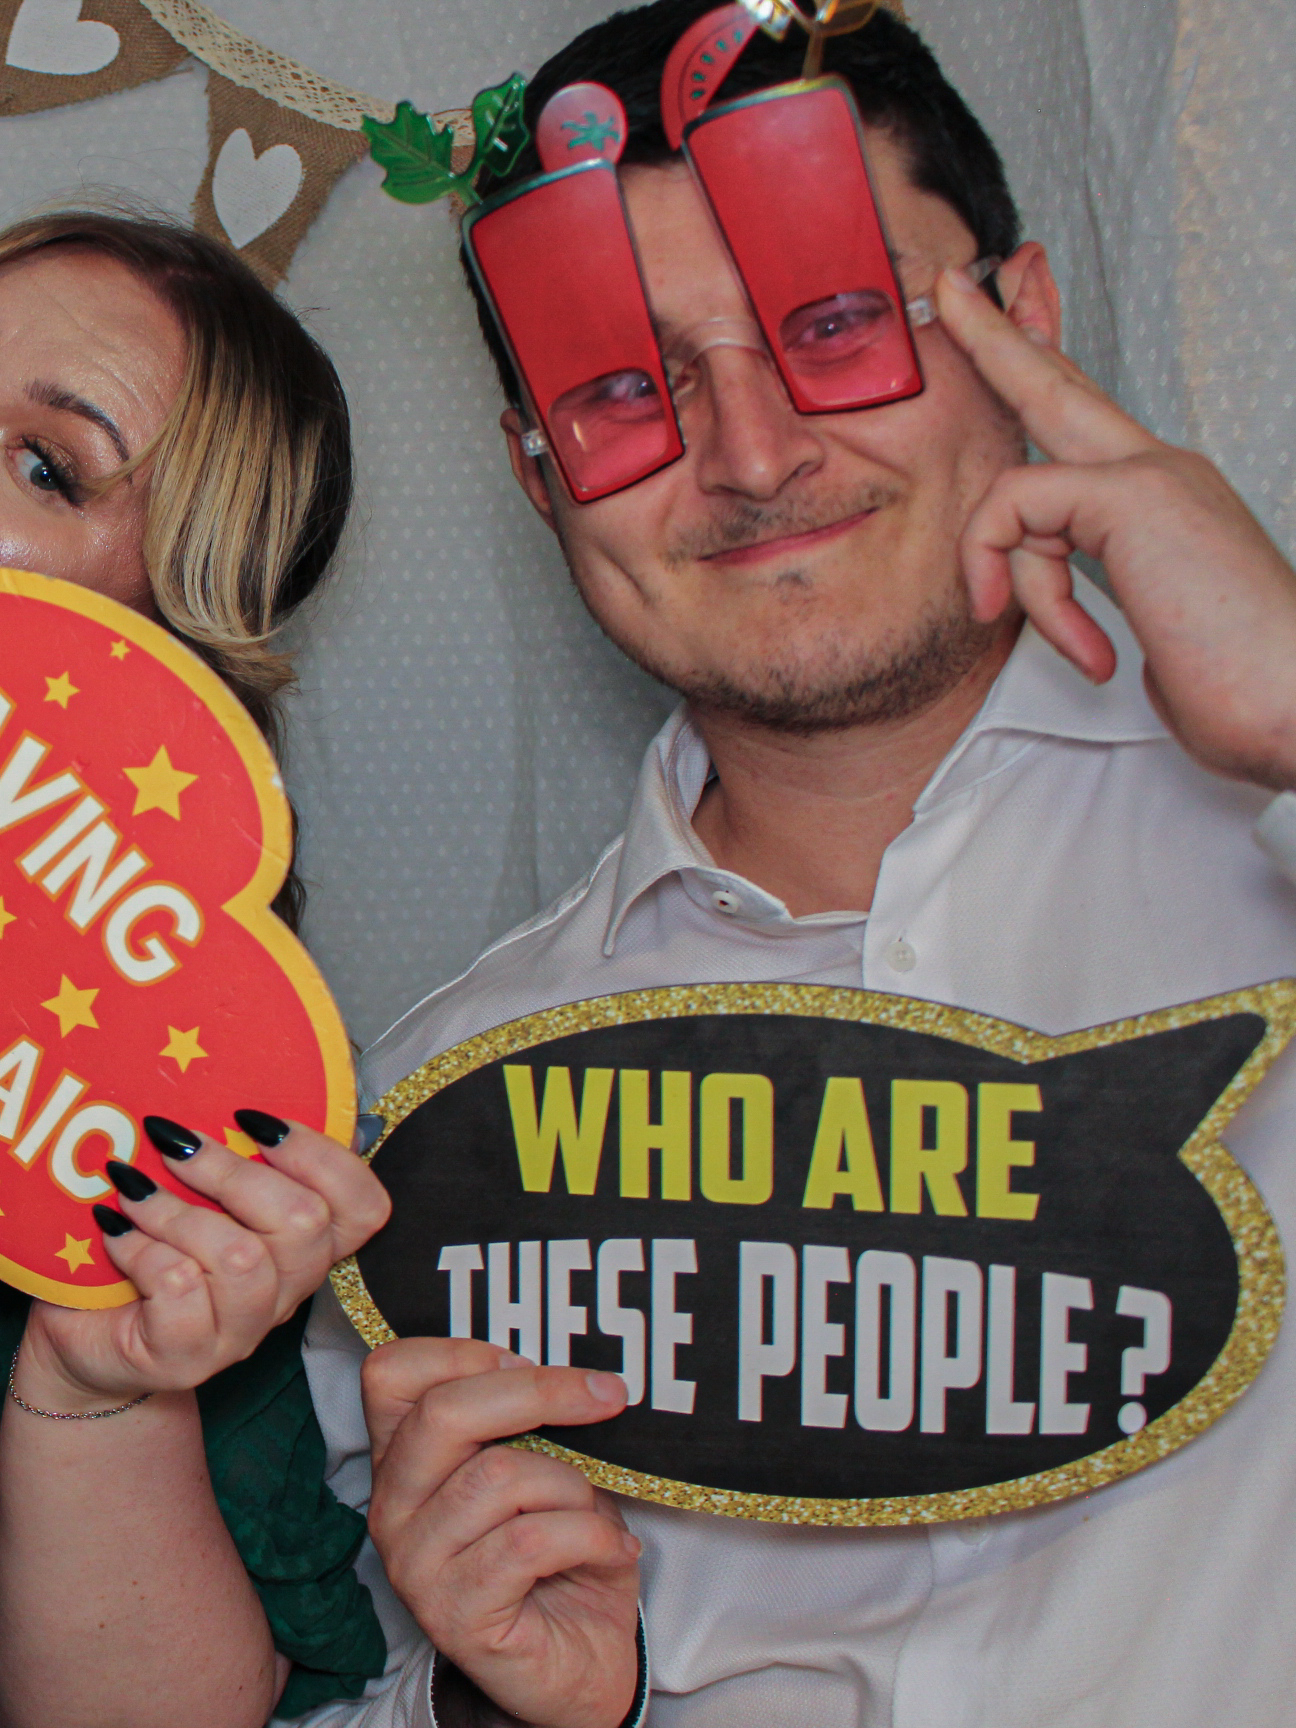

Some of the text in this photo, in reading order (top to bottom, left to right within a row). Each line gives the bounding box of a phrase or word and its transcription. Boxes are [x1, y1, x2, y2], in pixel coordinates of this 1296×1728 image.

[503, 1064, 1043, 1221] WHO ARE
[436, 1237, 700, 1416] THESE
